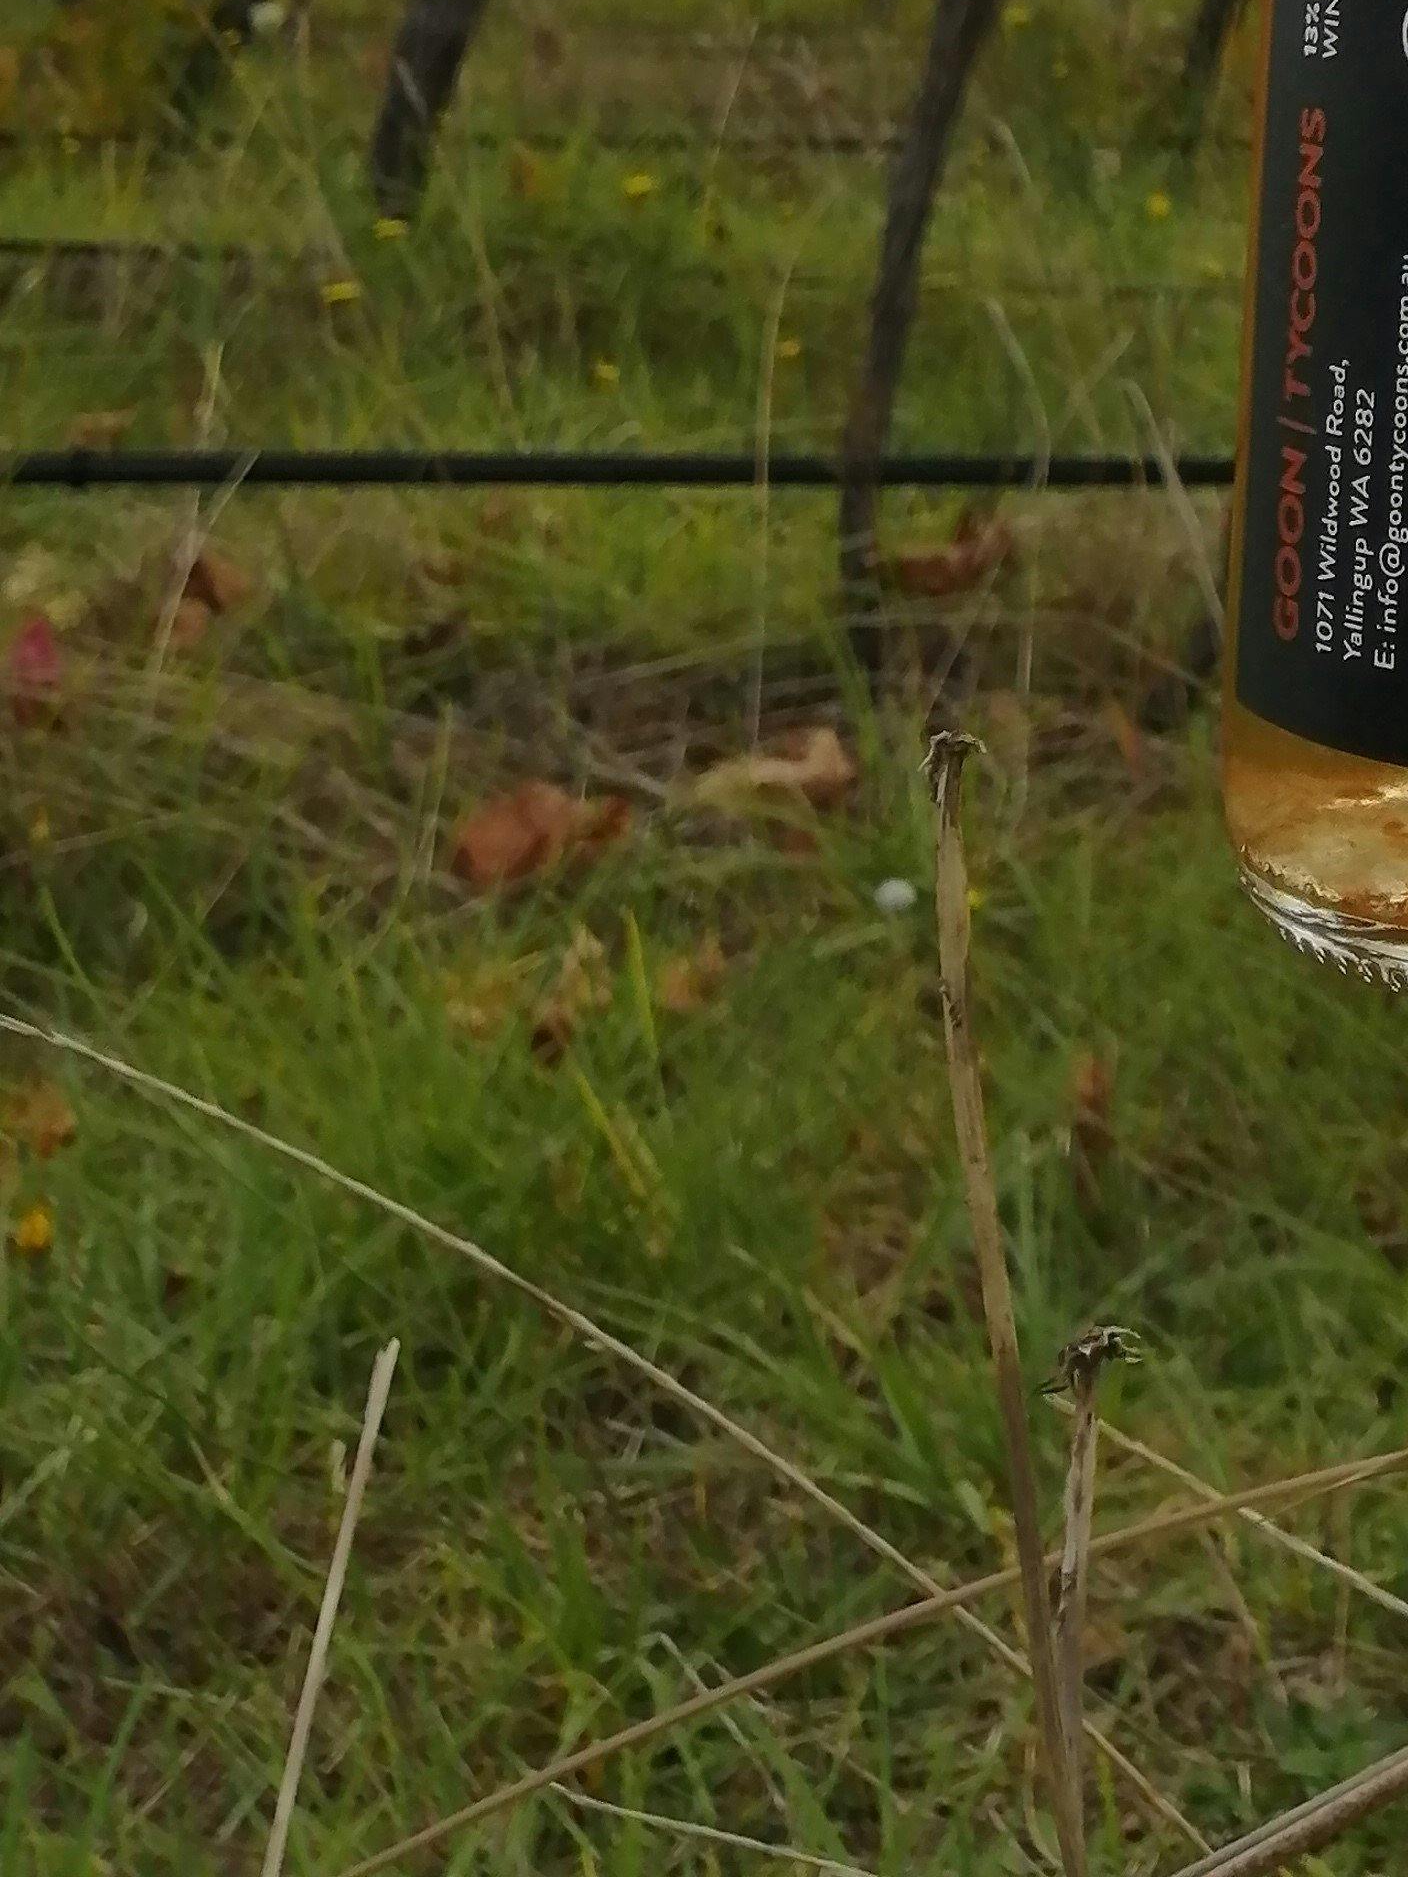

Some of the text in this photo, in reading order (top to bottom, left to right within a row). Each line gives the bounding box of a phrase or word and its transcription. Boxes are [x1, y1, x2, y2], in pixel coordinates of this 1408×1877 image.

[1302, 2, 1321, 58] 13%
[1273, 107, 1328, 641] GOON TYCOONS
[1315, 359, 1351, 653] 1071 Wildwood Road,
[1342, 388, 1375, 661] Yallingup WA 6282
[1373, 641, 1396, 670] E:
